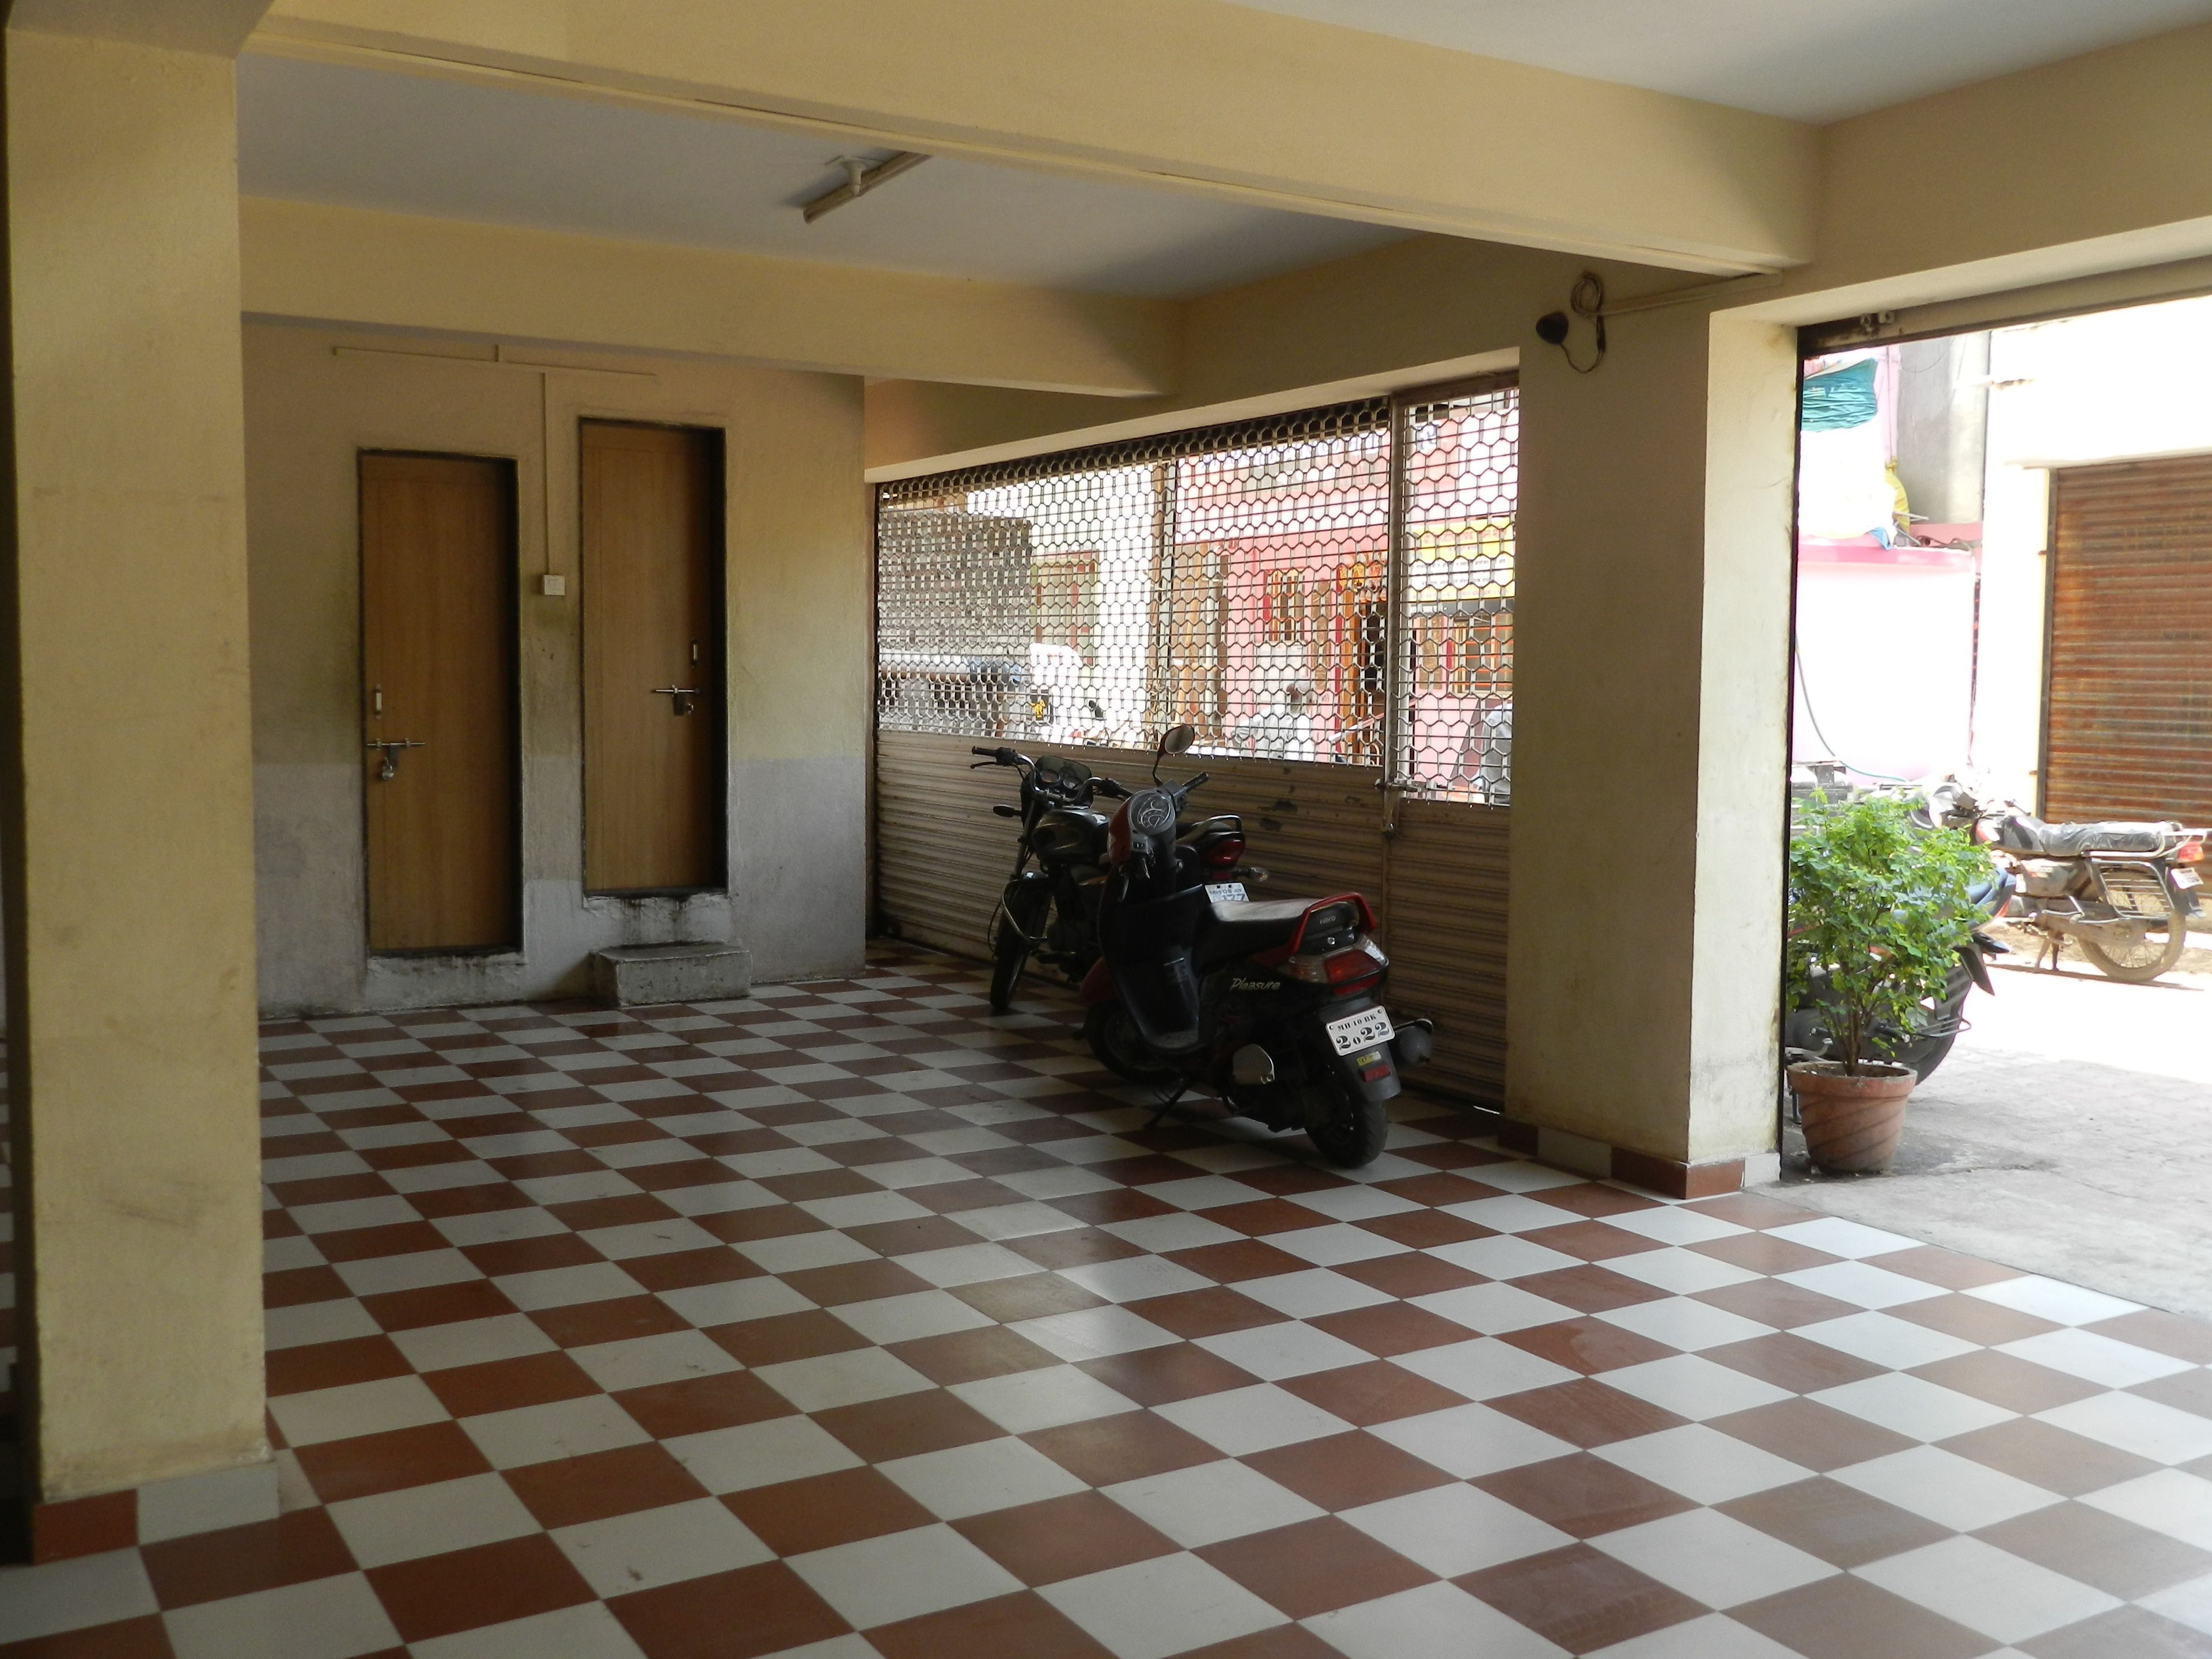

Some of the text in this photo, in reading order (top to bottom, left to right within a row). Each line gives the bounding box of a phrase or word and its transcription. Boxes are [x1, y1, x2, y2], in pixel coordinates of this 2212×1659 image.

[1320, 916, 1336, 925] Hero
[1230, 978, 1281, 991] Pleasure
[1336, 1022, 1389, 1050] 2022
